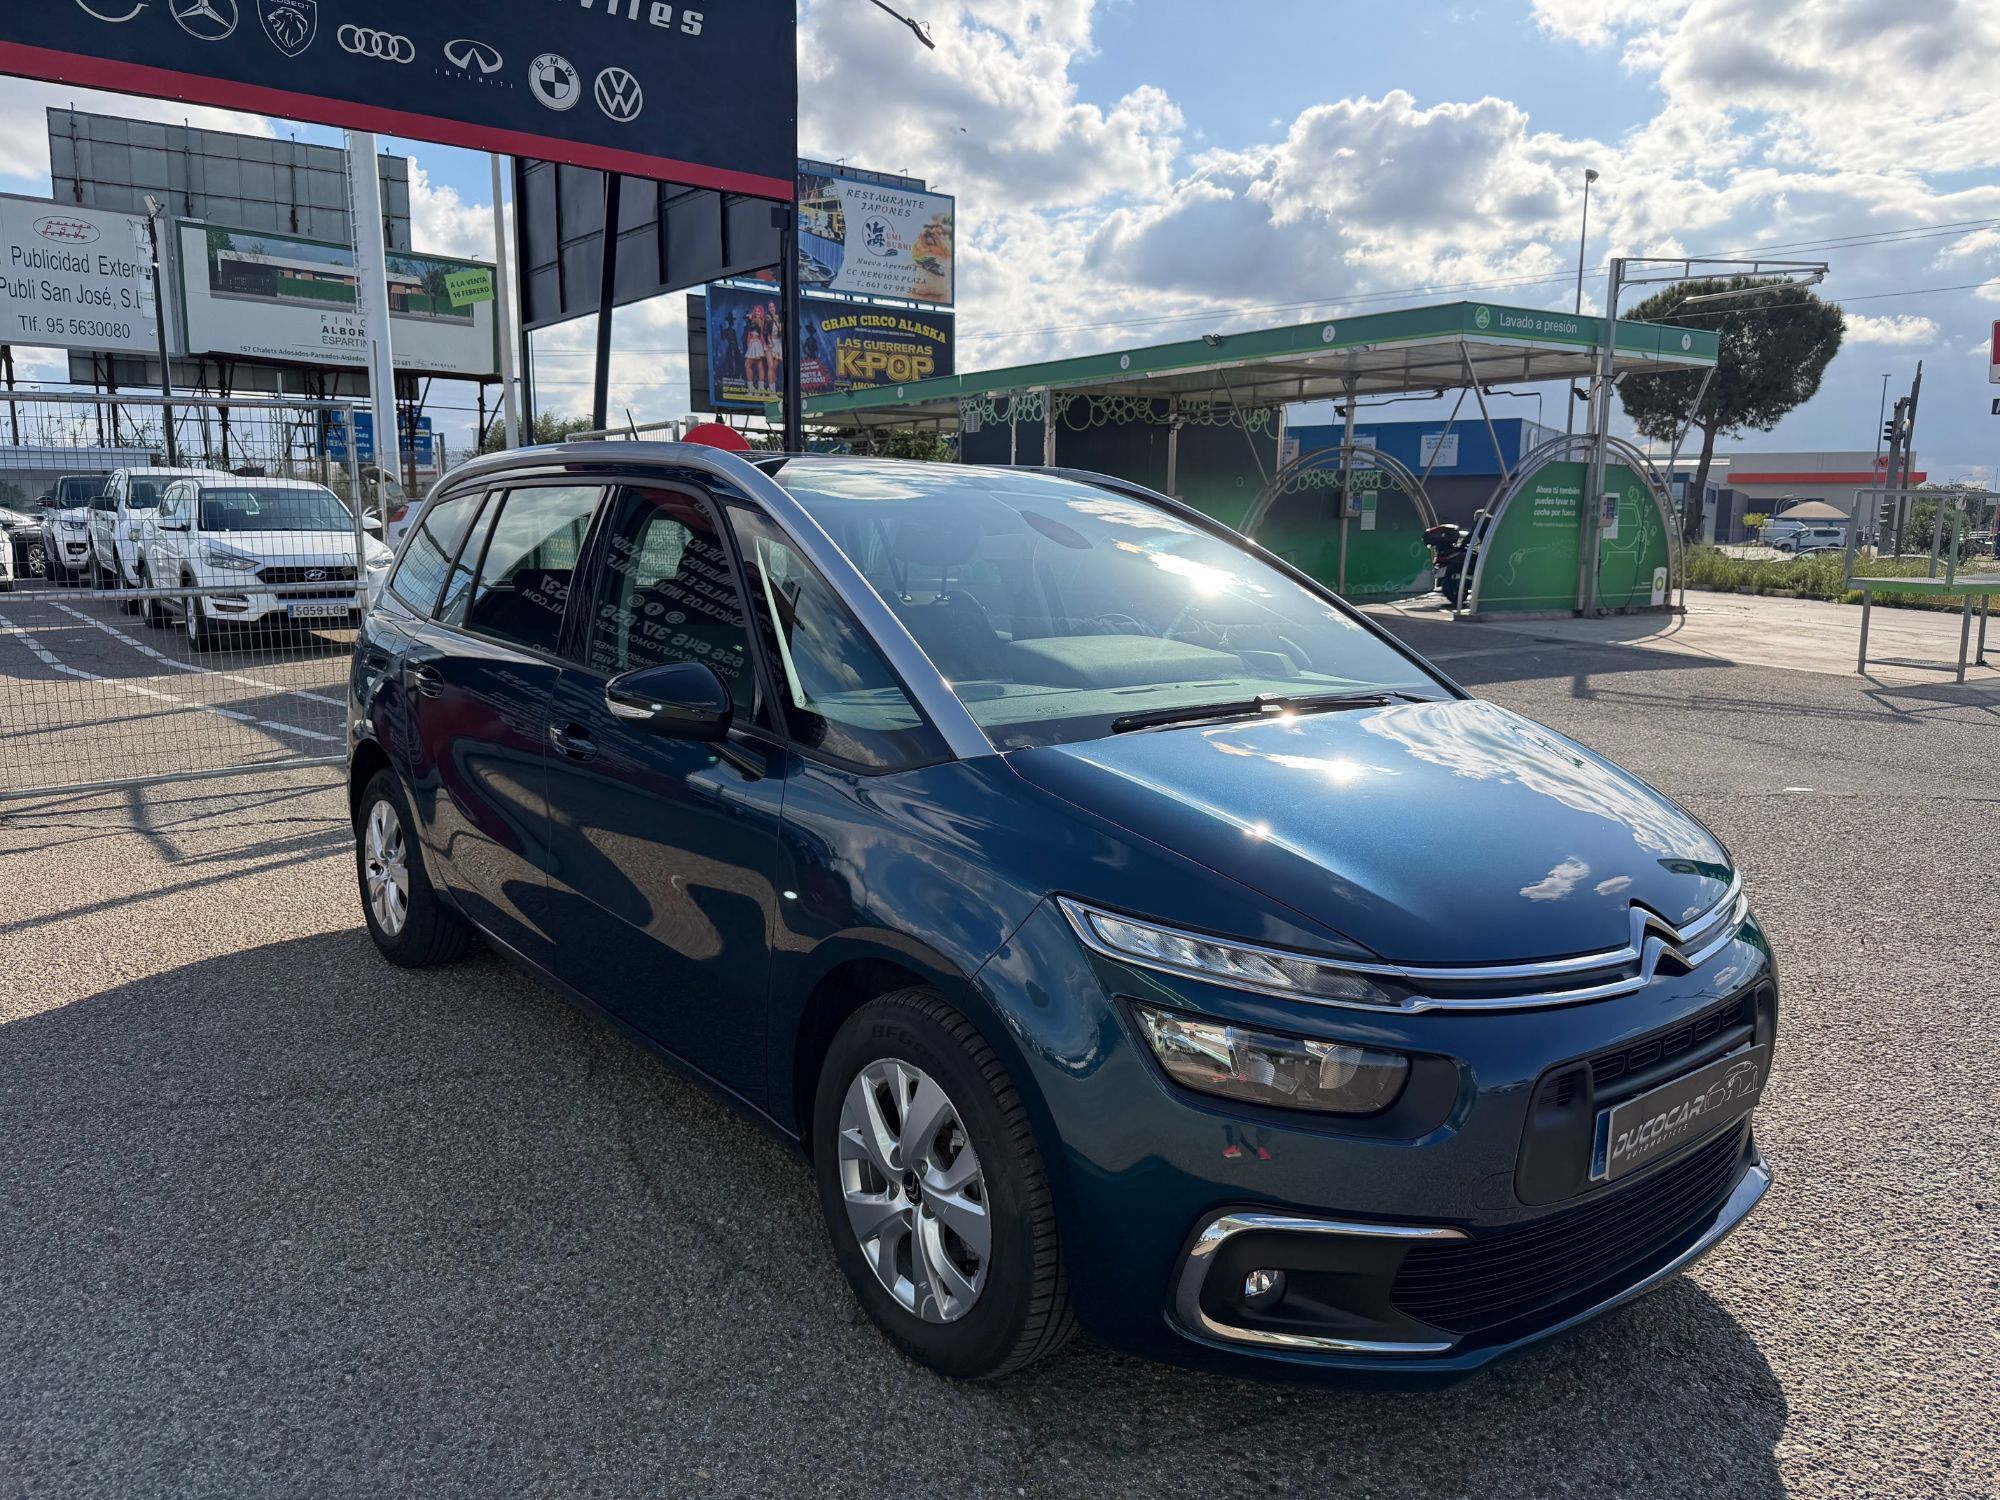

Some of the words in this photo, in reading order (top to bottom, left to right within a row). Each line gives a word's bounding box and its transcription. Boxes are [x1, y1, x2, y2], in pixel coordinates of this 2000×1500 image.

[534, 56, 575, 78] BMW
[435, 67, 513, 89] INFINITI
[846, 188, 926, 209] RESTAURANTE
[861, 202, 912, 217] JAPONES
[11, 245, 90, 273] Publicidad
[450, 281, 456, 289] A
[456, 280, 465, 288] LA
[465, 276, 487, 286] VENTA
[901, 276, 927, 285] PLAZA
[40, 280, 71, 303] San
[76, 284, 117, 310] José,
[461, 286, 490, 297] FEBRERO
[18, 314, 42, 332] Tlf.
[46, 317, 65, 334] 95
[69, 319, 131, 339] 5630080
[821, 315, 857, 331] GRAN
[860, 315, 896, 328] CIRCO
[898, 318, 946, 344] ALASKA
[1500, 312, 1534, 329] Lavado
[1535, 320, 1542, 330] a
[1544, 320, 1578, 334] presión
[836, 337, 861, 349] LAS
[863, 340, 933, 356] GUERRERAS
[837, 349, 934, 382] K-POP
[1535, 485, 1552, 494] Ahora
[1534, 497, 1555, 506] puedes
[1555, 496, 1569, 505] lavar
[1533, 508, 1550, 516] coche
[1551, 509, 1561, 517] por
[1561, 508, 1576, 517] fuera
[1612, 1094, 1706, 1161] DUCOCAR
